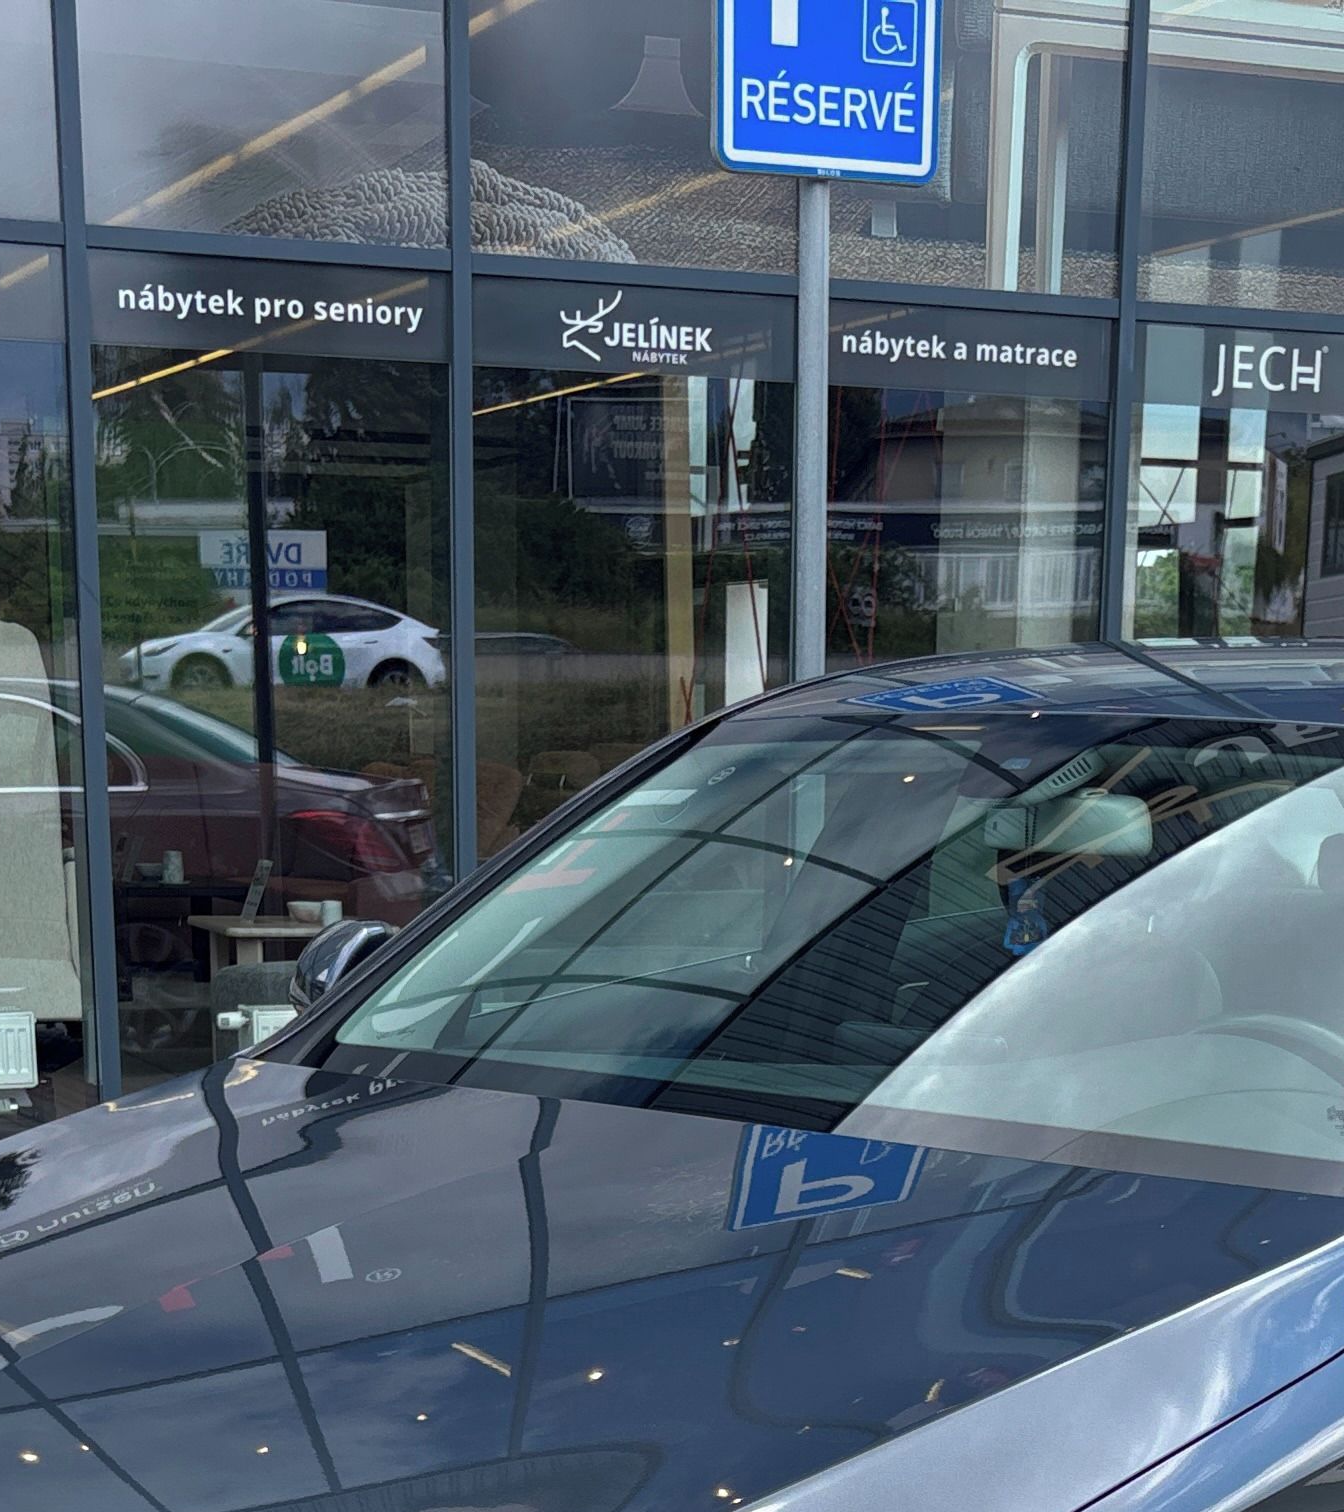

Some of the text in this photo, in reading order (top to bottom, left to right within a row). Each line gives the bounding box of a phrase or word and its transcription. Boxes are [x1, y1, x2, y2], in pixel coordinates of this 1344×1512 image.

[741, 69, 916, 134] RÉSERVÉ
[118, 283, 423, 333] nábytek pro seniory
[604, 317, 713, 353] JELÍNEK
[842, 330, 1077, 368] nábytek a matrace
[631, 350, 689, 365] NÁBYTEK
[1211, 343, 1322, 397] JECH
